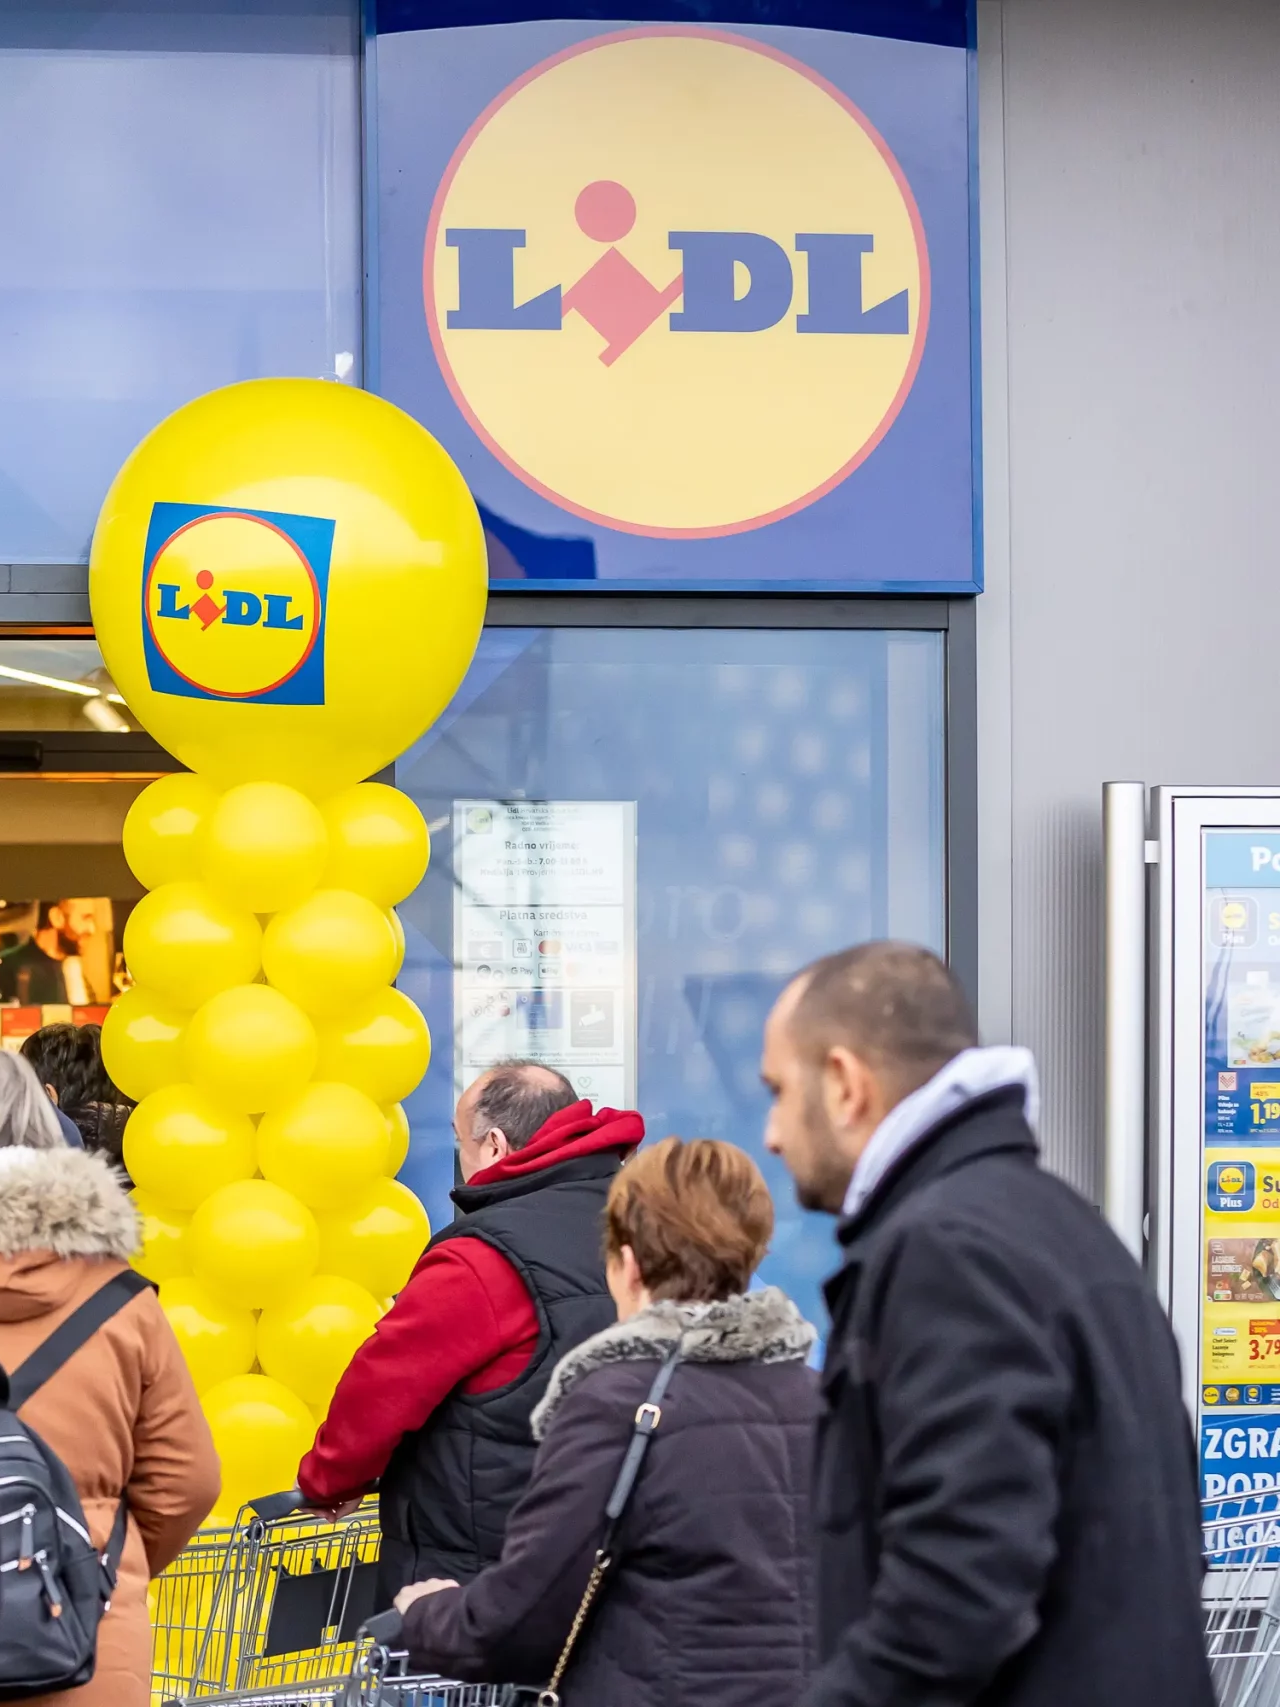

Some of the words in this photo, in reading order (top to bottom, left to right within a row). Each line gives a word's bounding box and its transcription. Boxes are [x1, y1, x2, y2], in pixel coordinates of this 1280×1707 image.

[505, 840, 537, 851] Radno
[499, 910, 537, 921] Platna
[539, 910, 588, 921] sredstva
[1219, 1196, 1243, 1208] Plus
